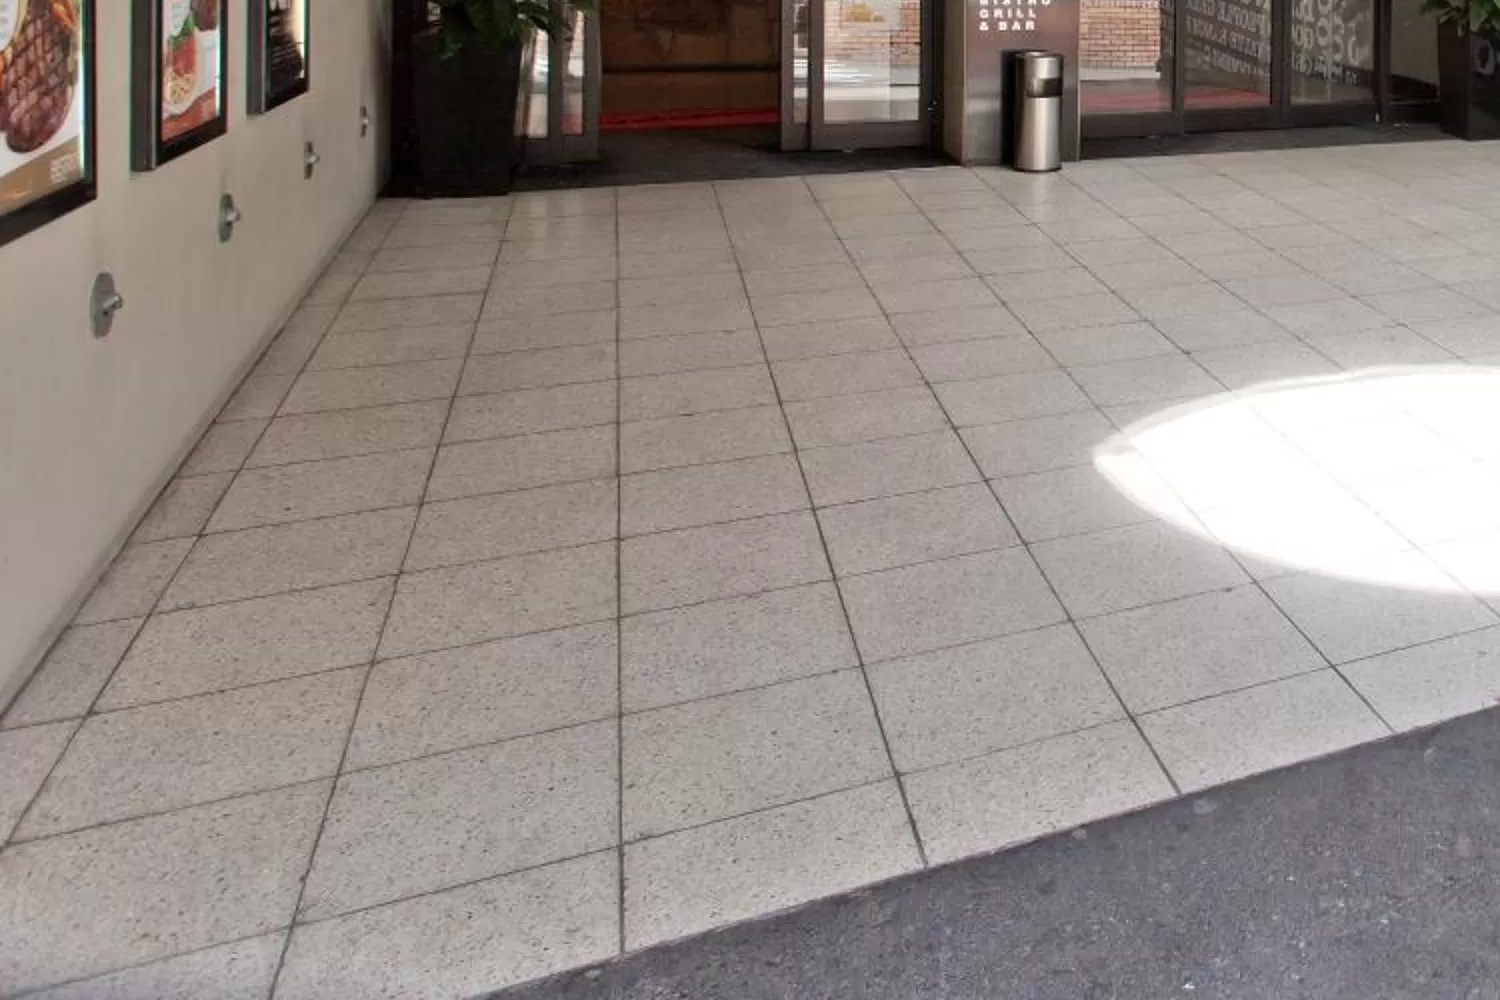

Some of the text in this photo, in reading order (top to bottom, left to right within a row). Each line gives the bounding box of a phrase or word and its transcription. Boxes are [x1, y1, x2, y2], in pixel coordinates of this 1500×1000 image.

[979, 8, 1037, 19] GRILL
[979, 20, 1036, 32] & BAR
